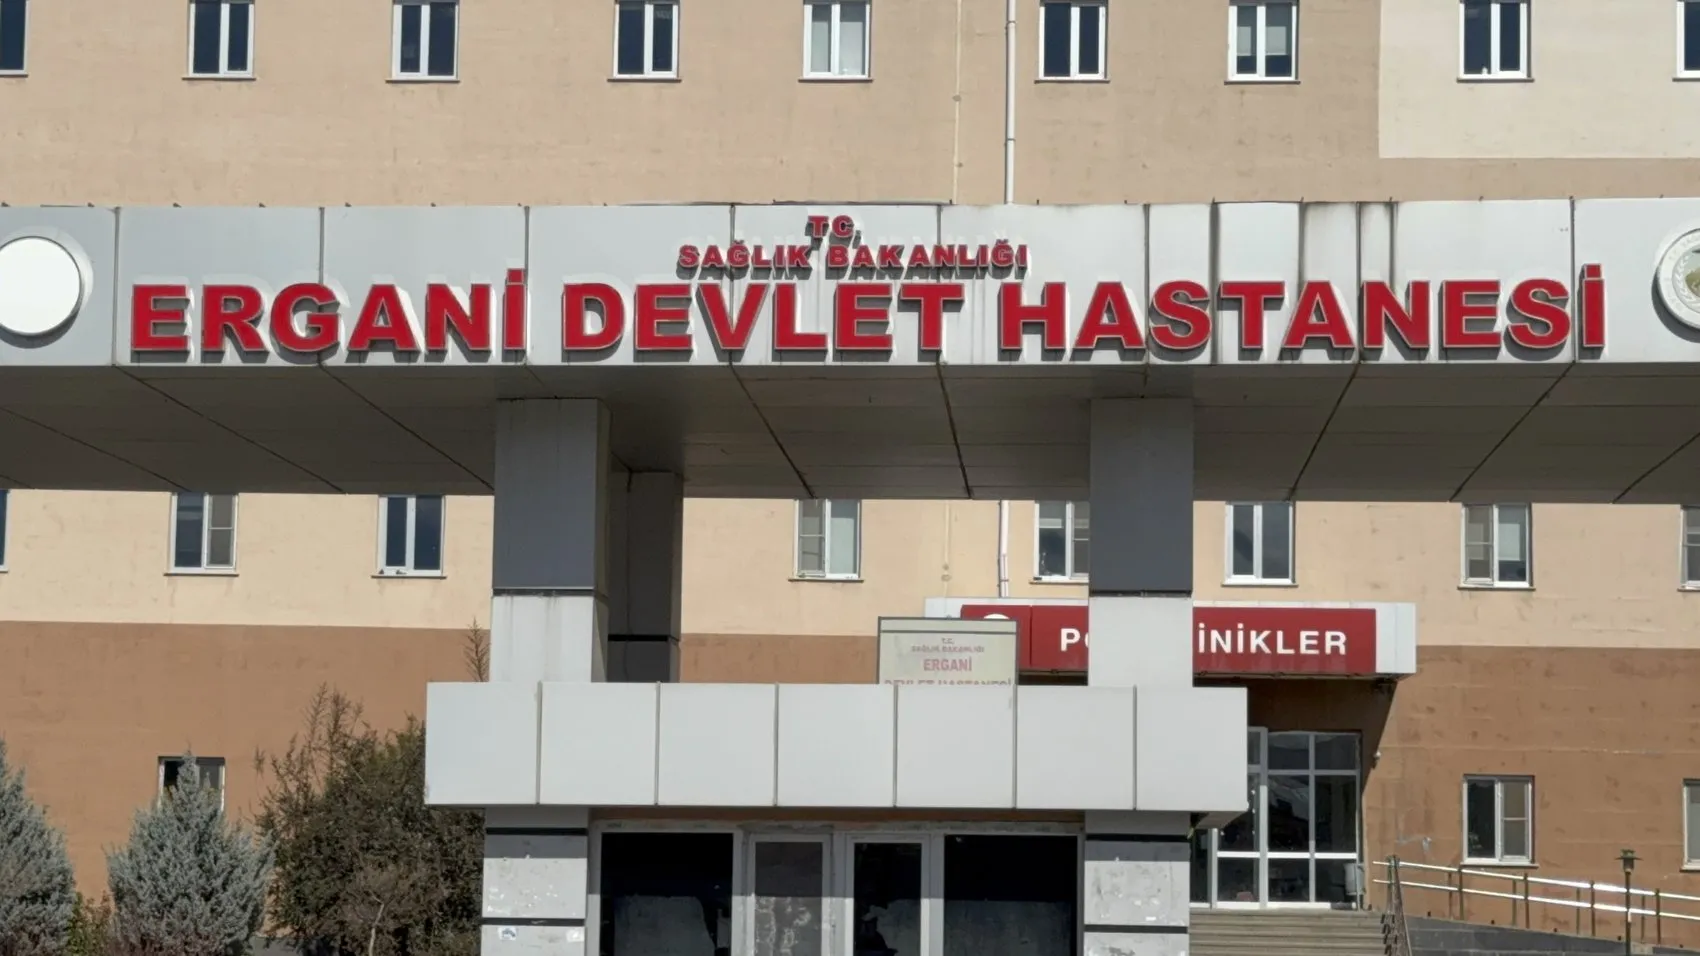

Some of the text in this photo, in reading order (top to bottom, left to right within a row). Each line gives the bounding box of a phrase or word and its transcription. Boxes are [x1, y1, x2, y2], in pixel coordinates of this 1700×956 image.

[678, 239, 1028, 267] SAĞLIK BAKANLIĞI
[131, 268, 526, 351] ERGANİ
[562, 282, 965, 350] DEVLET
[1000, 264, 1605, 350] HASTANESİ
[923, 656, 972, 671] ERGANİ
